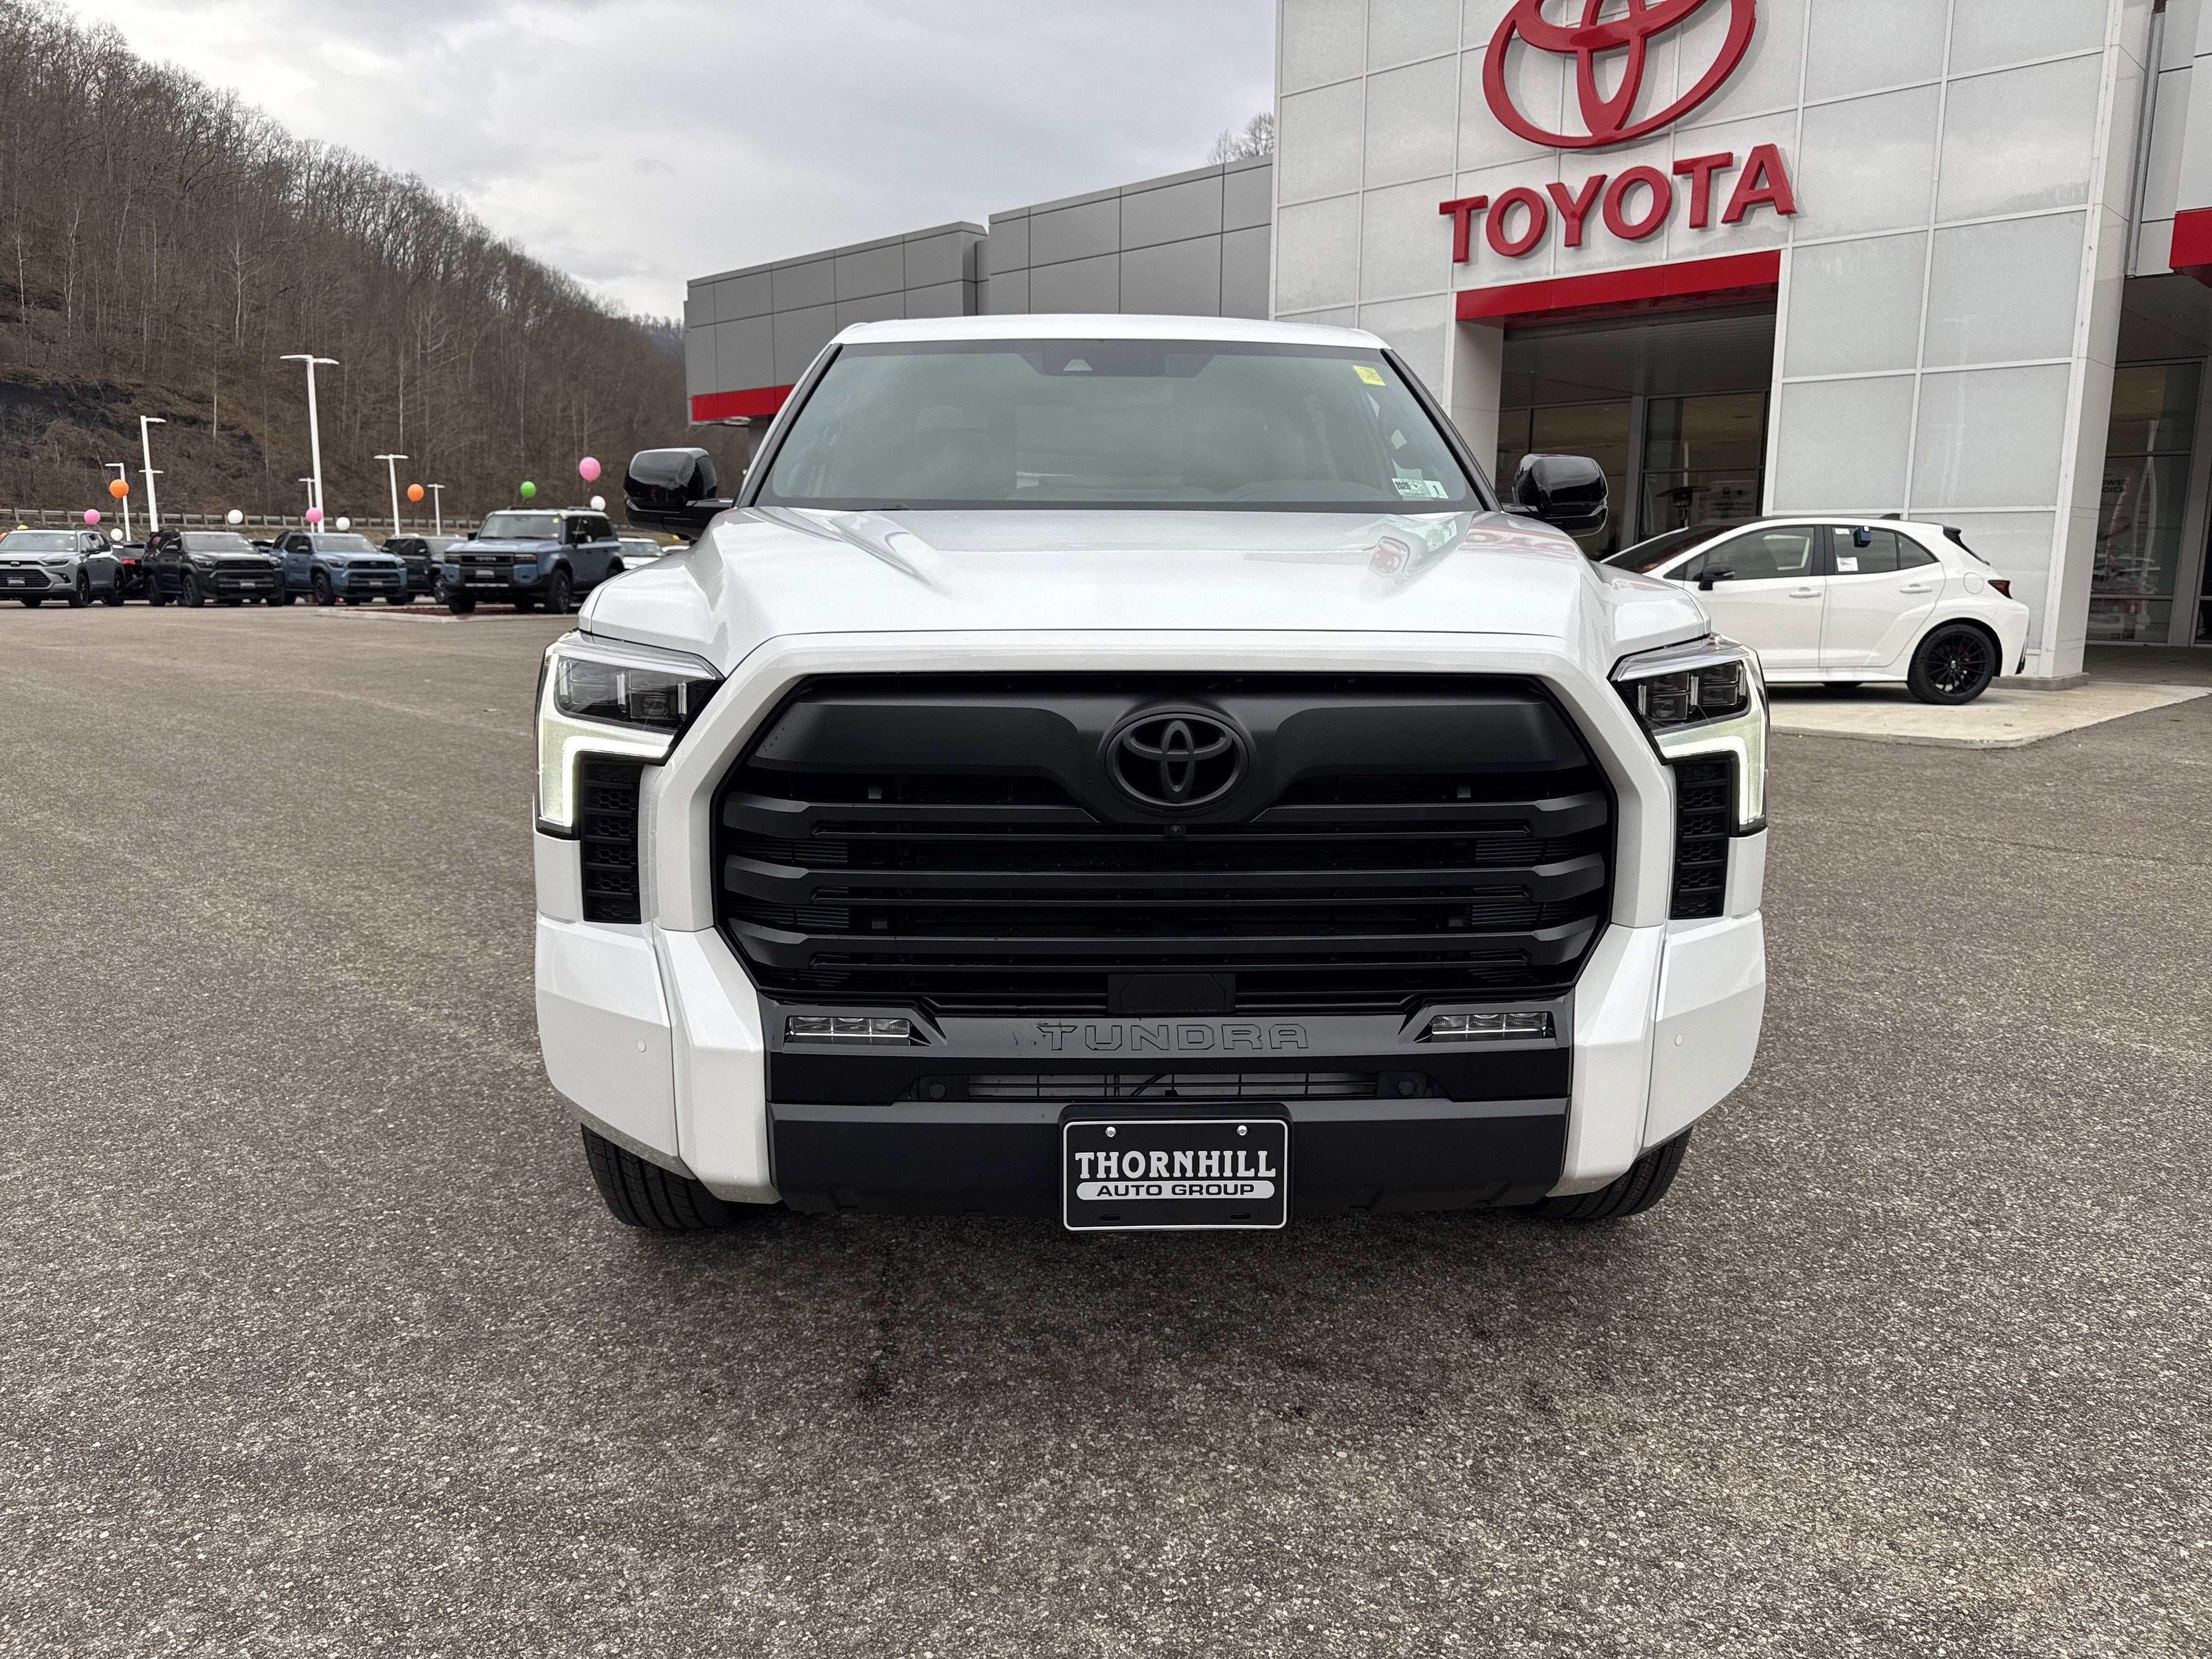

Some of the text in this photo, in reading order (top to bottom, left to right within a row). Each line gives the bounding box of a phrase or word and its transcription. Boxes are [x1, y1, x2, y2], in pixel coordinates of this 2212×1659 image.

[1439, 143, 1797, 264] TOYOTA
[1036, 1024, 1309, 1051] TUNDRA
[1075, 1150, 1276, 1179] THORNHILL
[1096, 1183, 1255, 1197] AUTO GROUP
